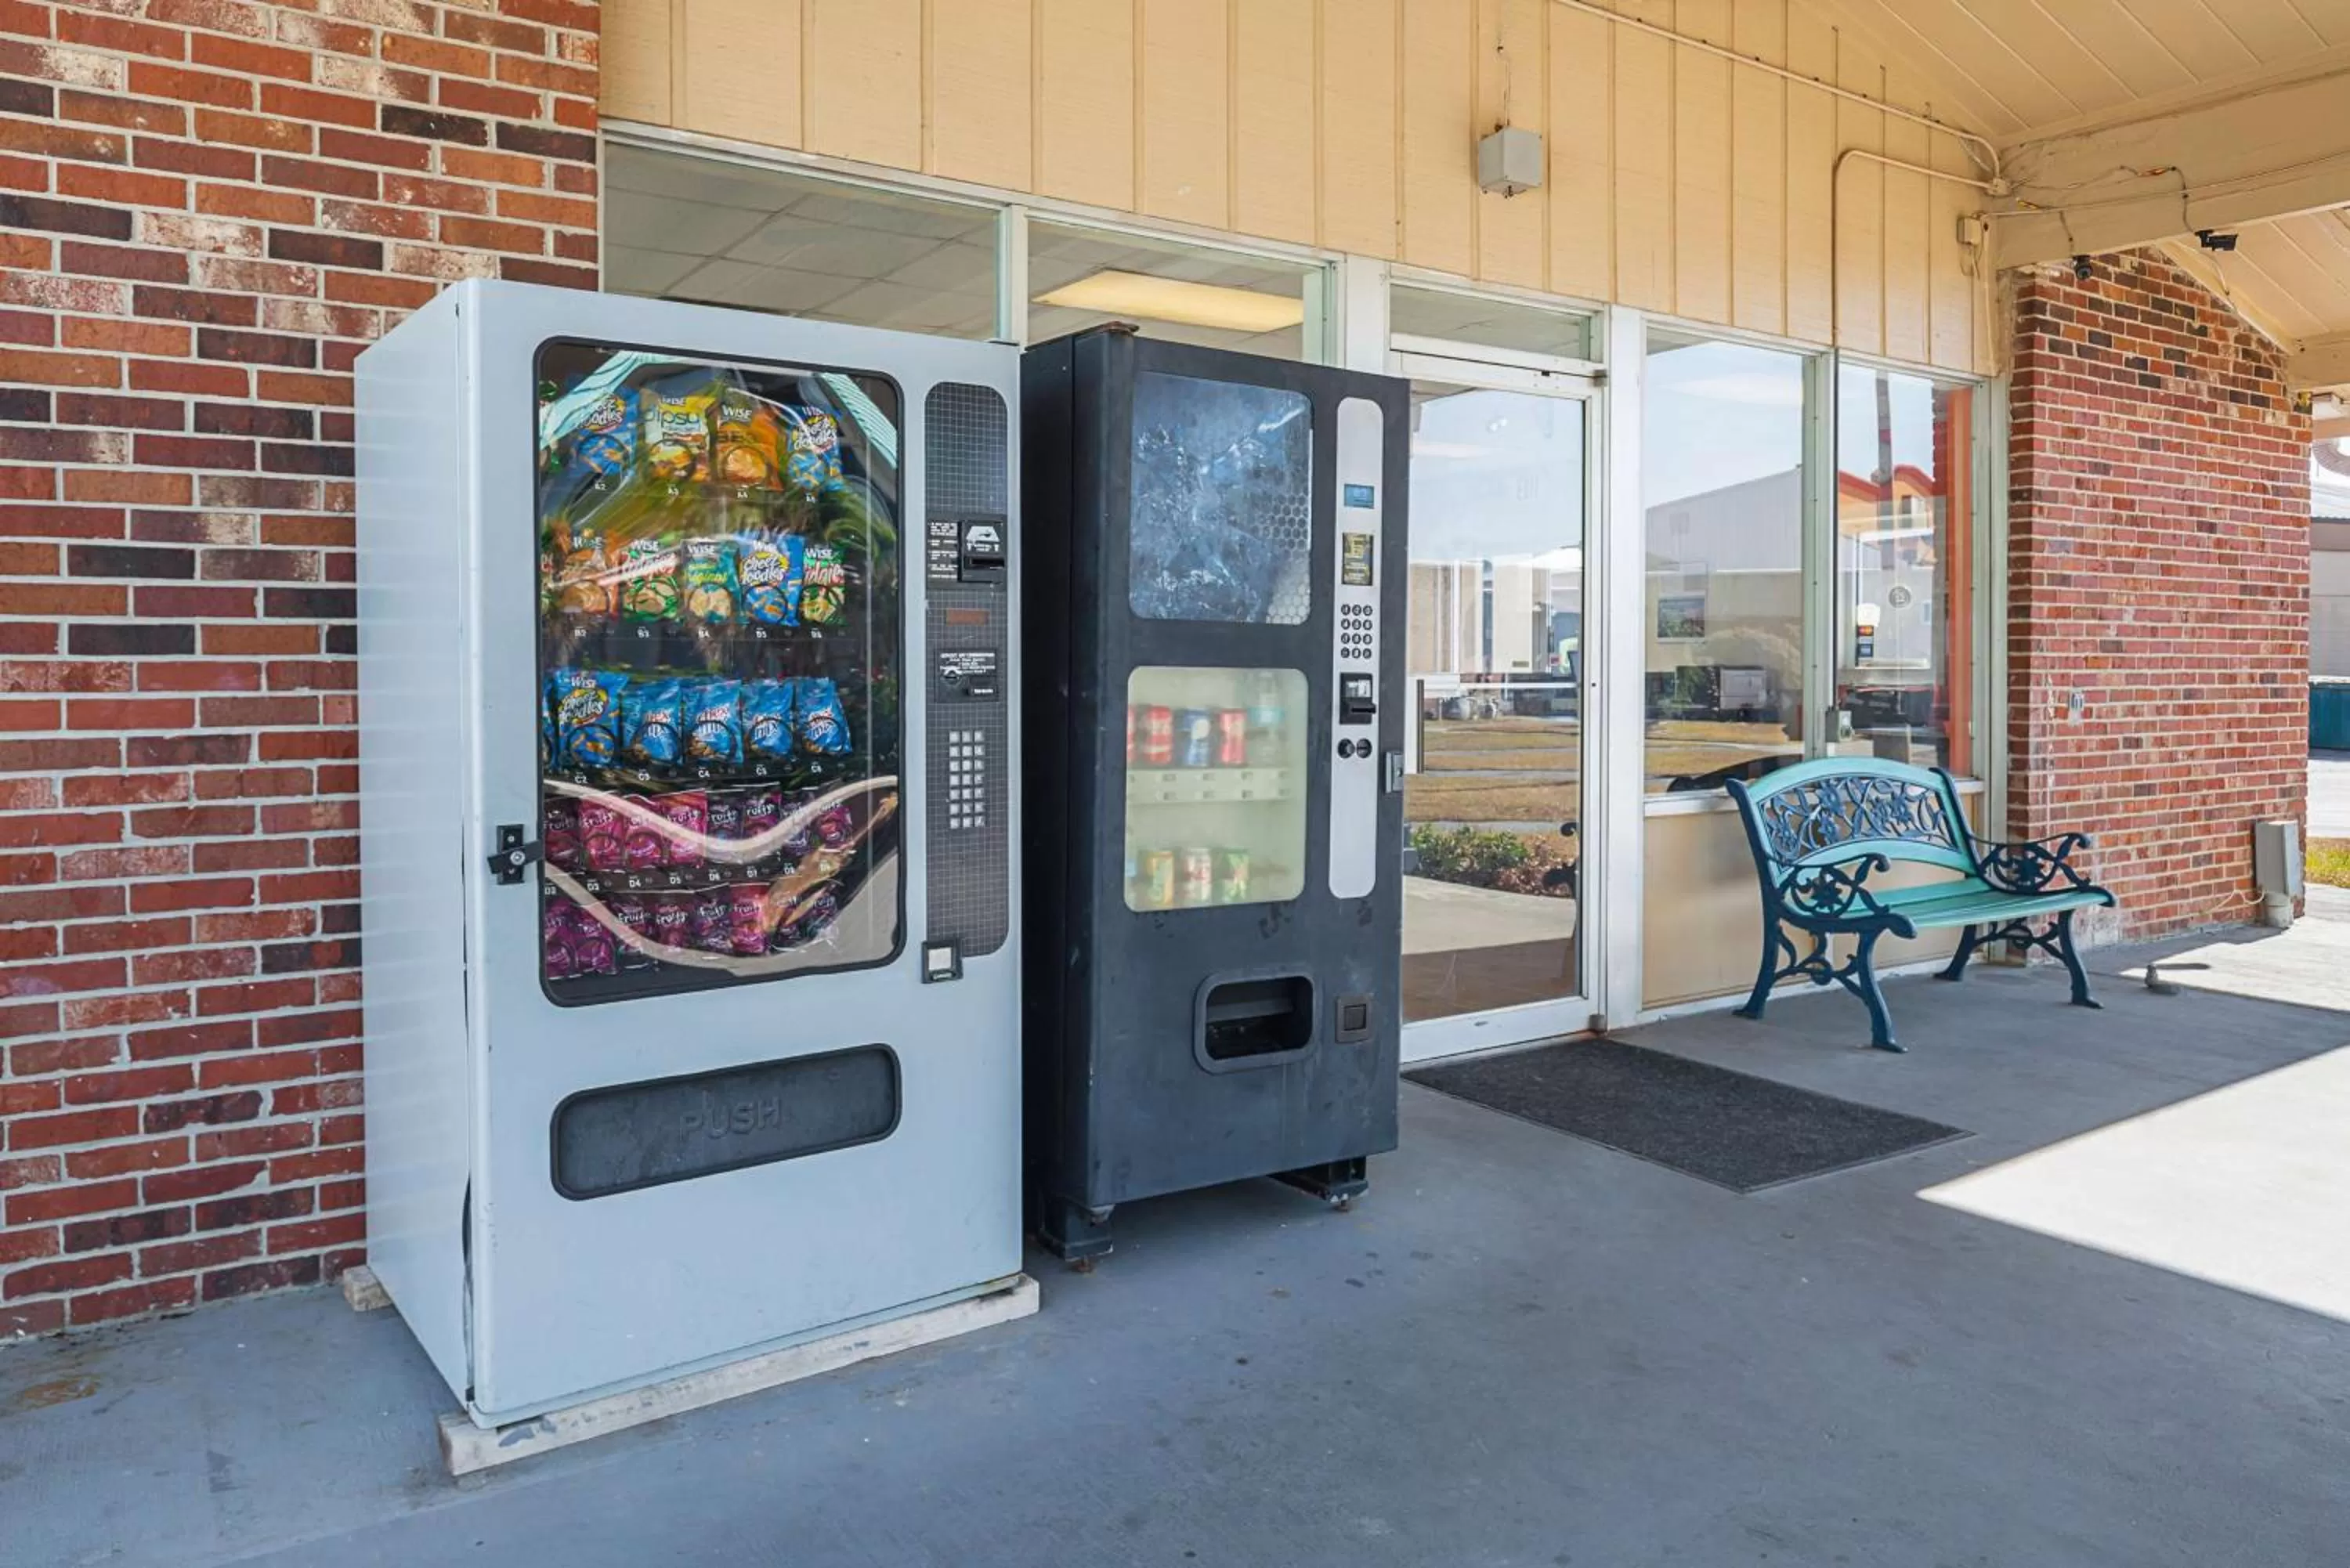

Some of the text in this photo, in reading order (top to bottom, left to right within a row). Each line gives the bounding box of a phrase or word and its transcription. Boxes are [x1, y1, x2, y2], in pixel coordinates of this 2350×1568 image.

[722, 405, 753, 420] WISE
[805, 548, 833, 561] WISE
[629, 880, 642, 888] D4
[679, 1097, 782, 1141] PUSH
